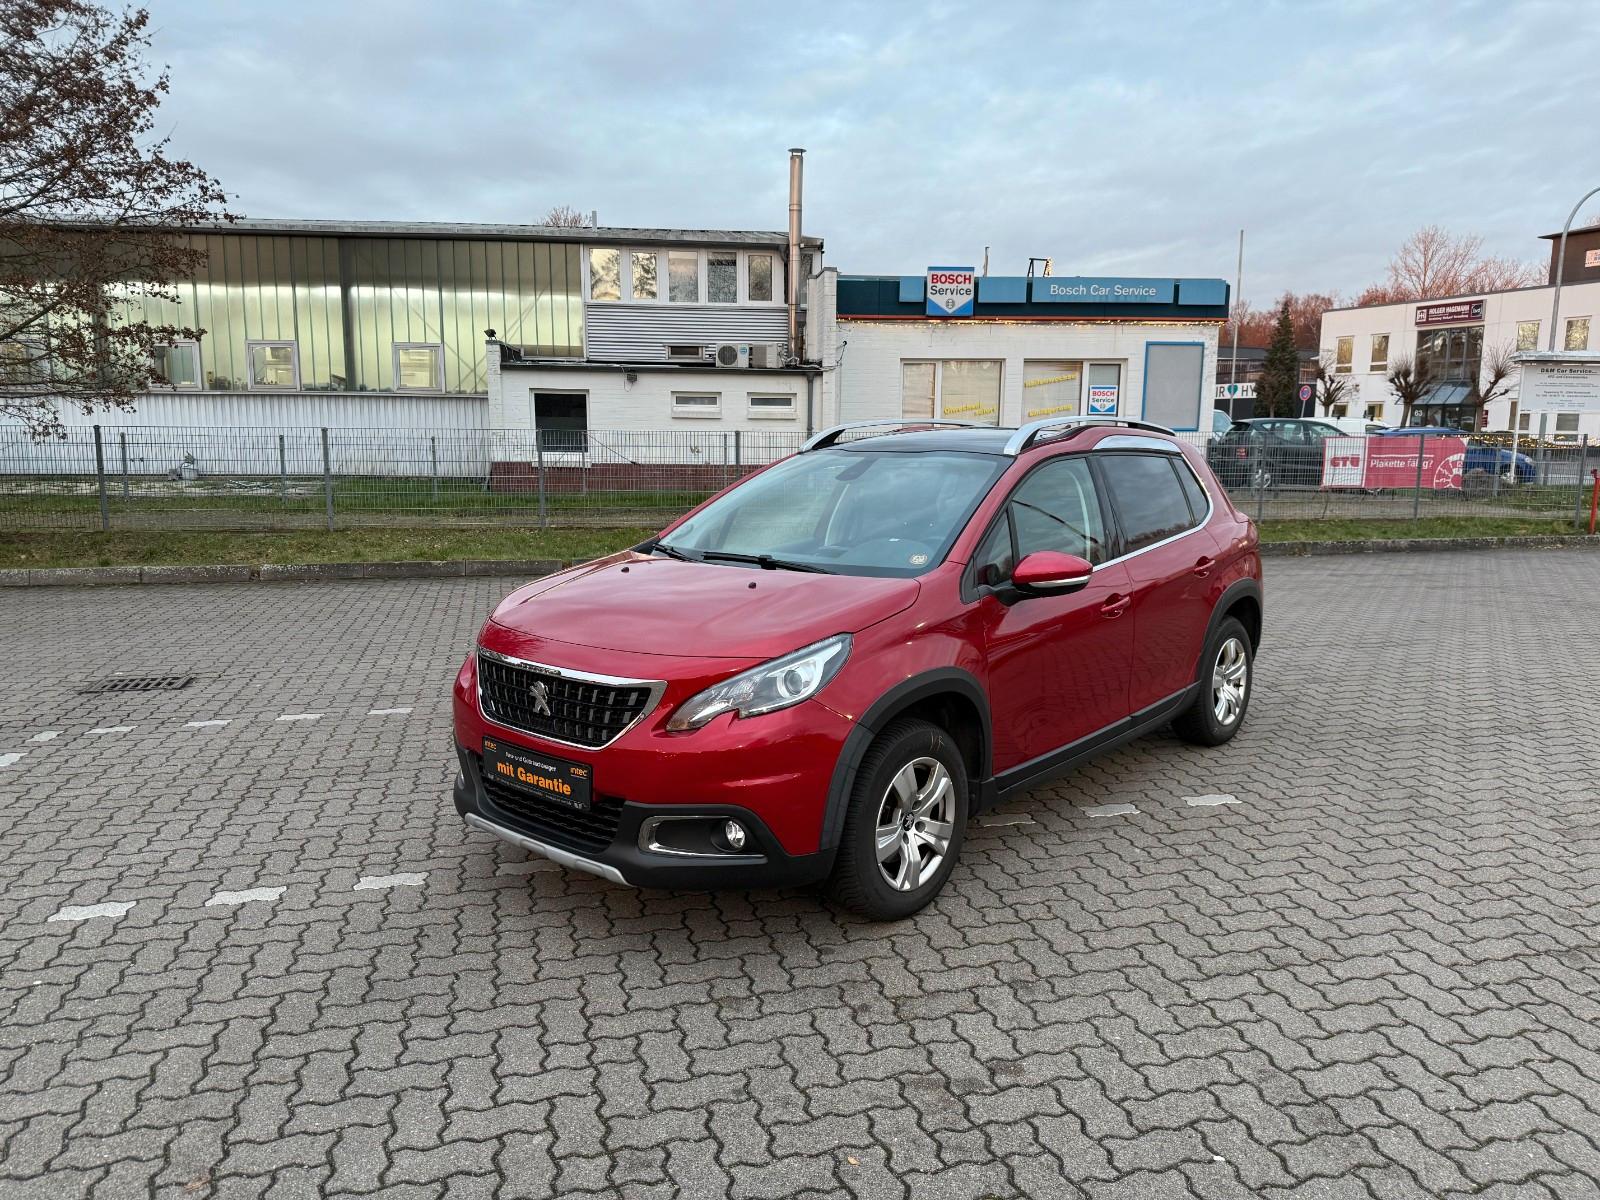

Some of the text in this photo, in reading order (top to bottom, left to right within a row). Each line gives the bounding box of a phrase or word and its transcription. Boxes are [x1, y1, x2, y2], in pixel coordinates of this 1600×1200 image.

[931, 274, 972, 284] BOSCH
[930, 285, 972, 296] Service
[1050, 284, 1157, 296] Bosch Car Service
[1215, 384, 1256, 398] IR HY
[1414, 409, 1423, 417] 63
[1370, 458, 1434, 470] Plakette fälg?
[497, 761, 515, 778] mit
[517, 767, 572, 796] Garantie
